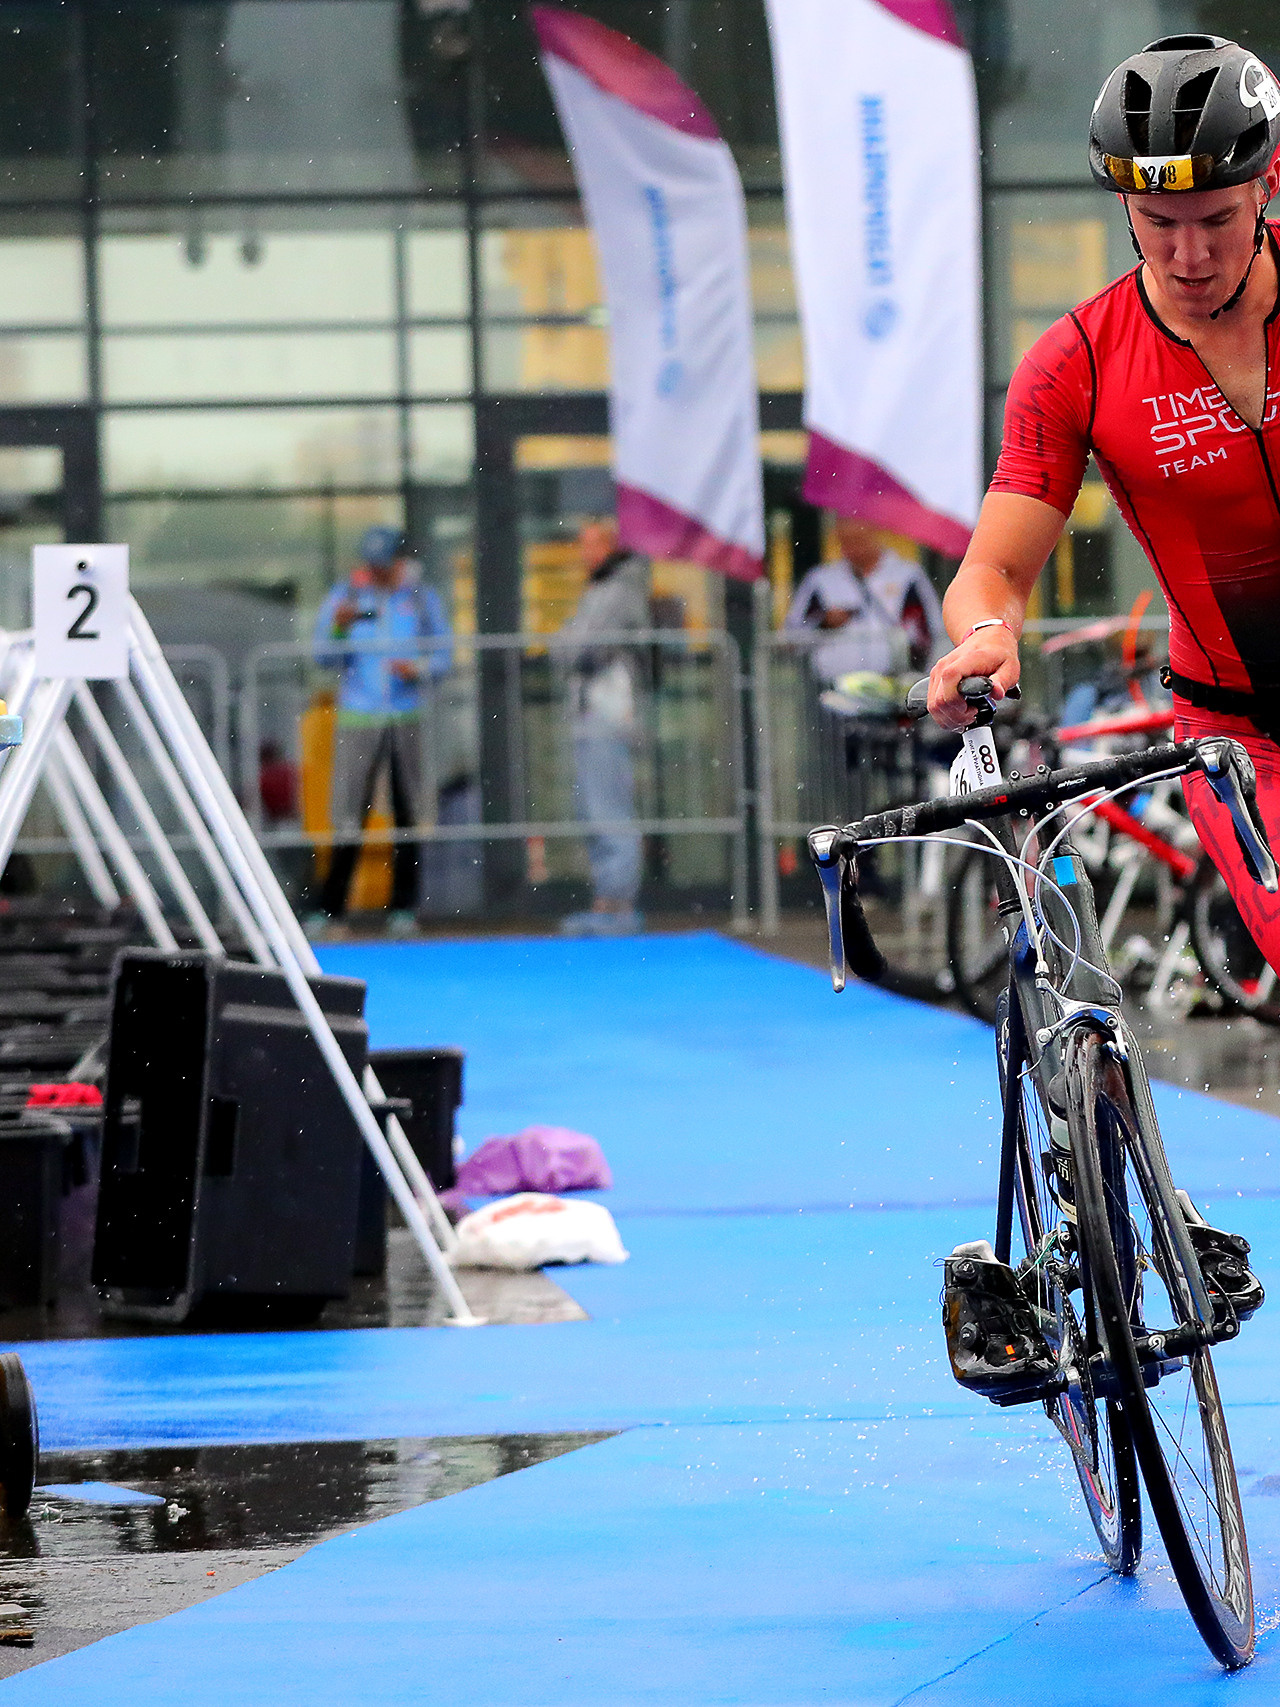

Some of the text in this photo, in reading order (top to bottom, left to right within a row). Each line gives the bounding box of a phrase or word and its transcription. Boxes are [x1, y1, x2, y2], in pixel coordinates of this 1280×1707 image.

[1141, 383, 1227, 421] TIME
[1158, 446, 1228, 478] TEAM
[67, 585, 100, 639] 2
